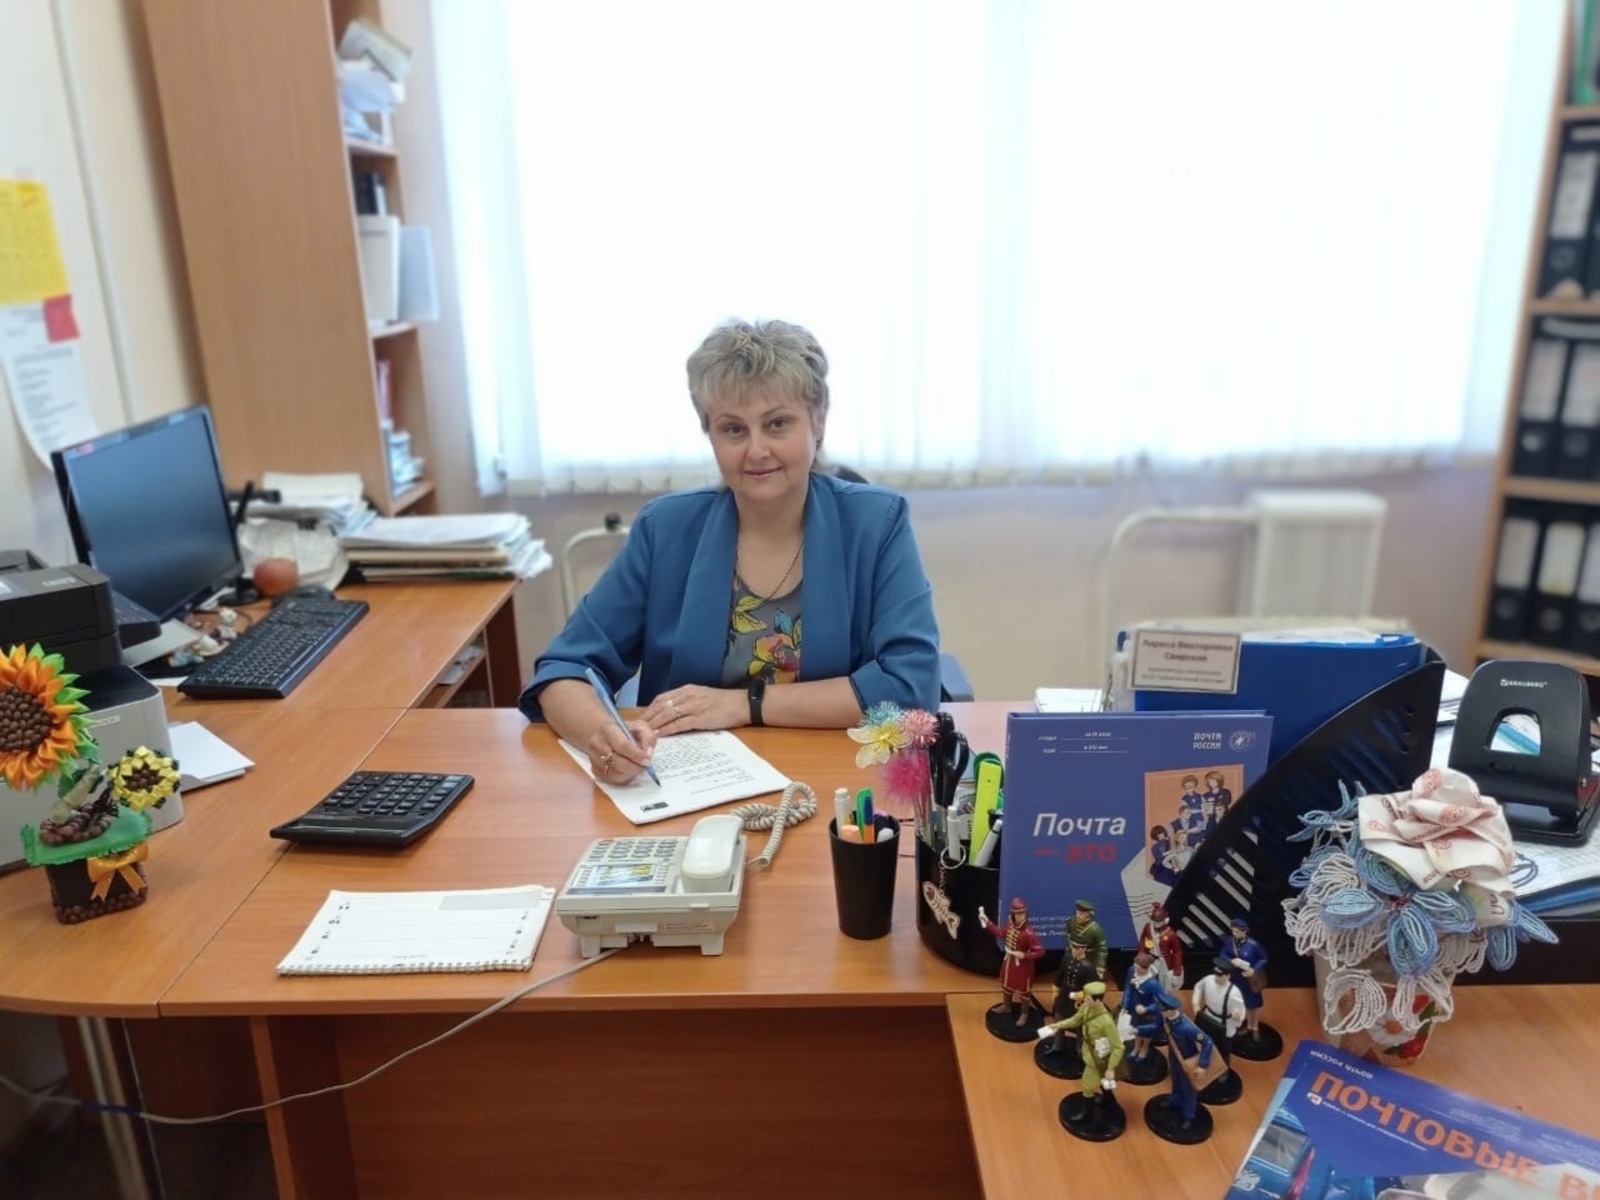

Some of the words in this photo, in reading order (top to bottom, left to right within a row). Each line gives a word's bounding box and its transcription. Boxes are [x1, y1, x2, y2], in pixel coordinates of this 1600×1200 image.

[1194, 732, 1222, 741] ПОЧТА
[1193, 741, 1221, 750] РОССИИ
[1033, 812, 1126, 837] Почта
[1311, 1071, 1542, 1184] ПОЧТОВЫЕ
